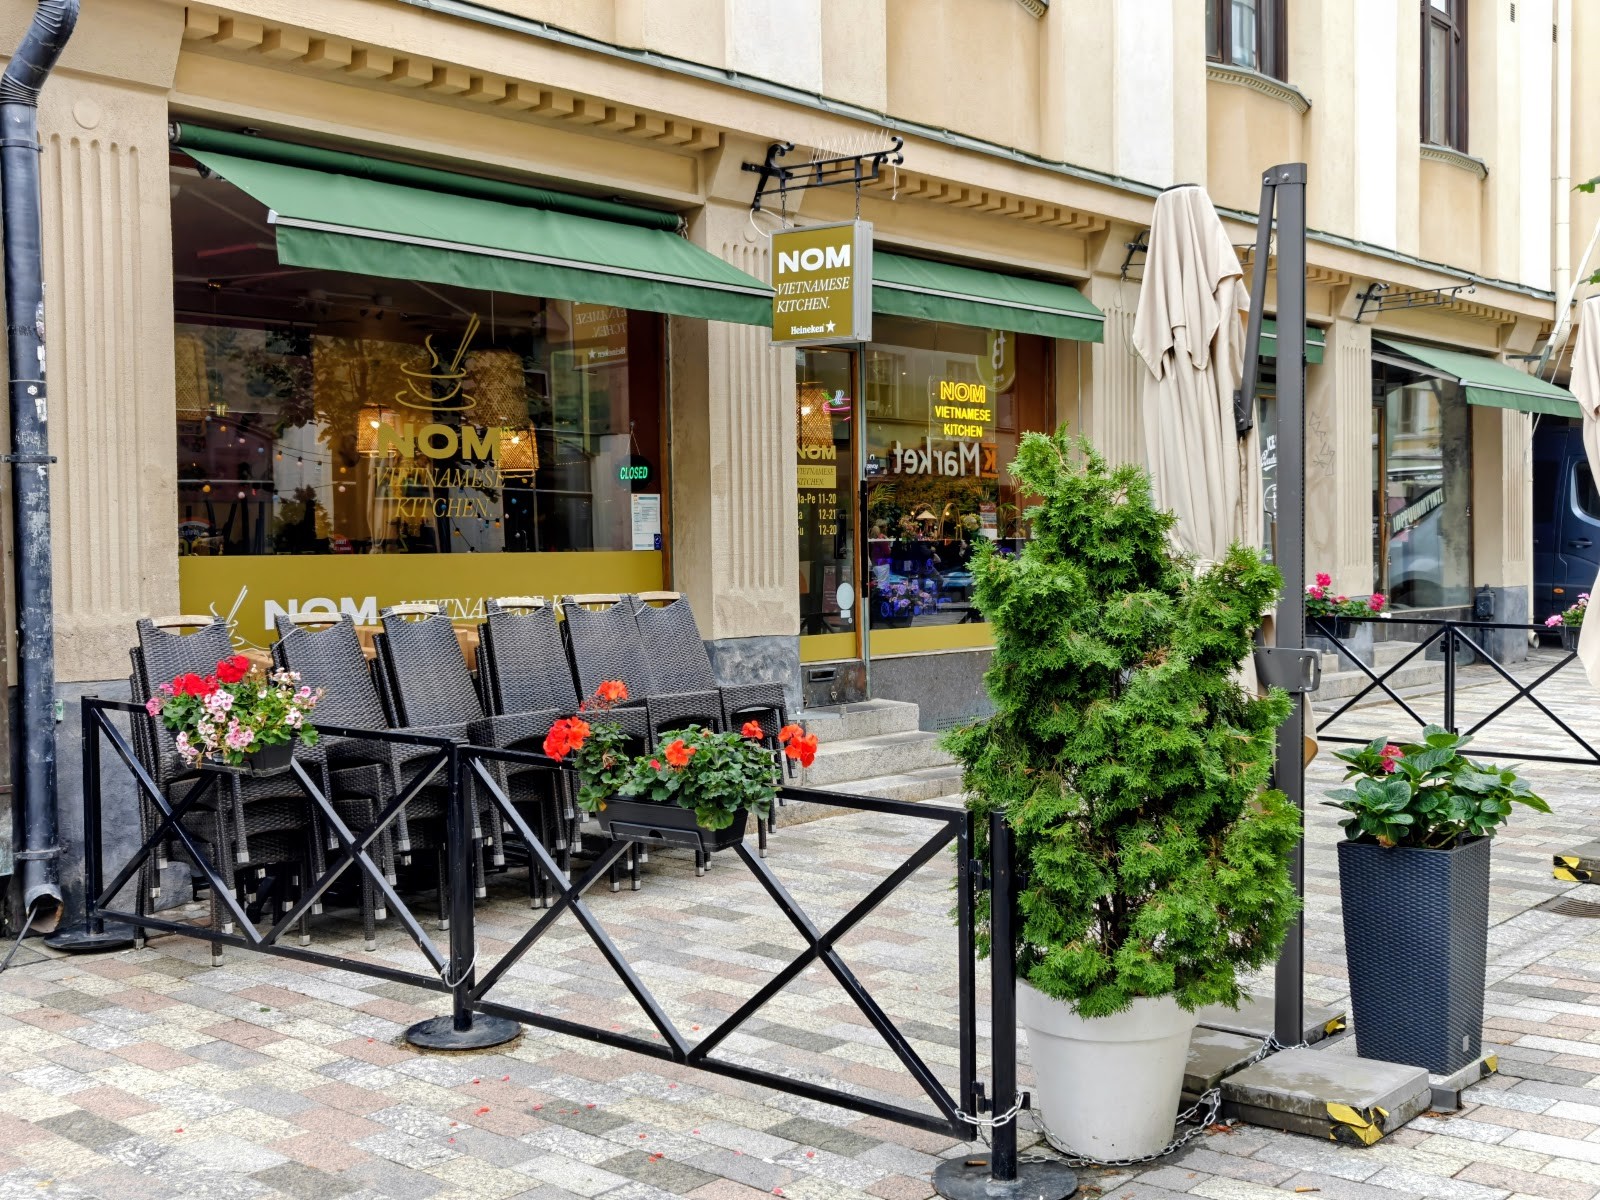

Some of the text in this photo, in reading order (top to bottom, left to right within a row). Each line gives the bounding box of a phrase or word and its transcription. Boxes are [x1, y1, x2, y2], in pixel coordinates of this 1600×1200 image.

[778, 244, 851, 273] NOM
[776, 277, 850, 296] VIETNAMESE
[776, 296, 831, 313] KITCHEN.
[790, 324, 825, 336] Heineken
[940, 380, 986, 404] NOM
[934, 405, 991, 422] VIETNAMESE
[943, 423, 983, 438] KITCHEN
[377, 423, 501, 460] NOM
[797, 444, 837, 460] NOM
[373, 467, 506, 488] VIETNAMESE
[619, 466, 648, 480] CLOSED
[818, 493, 837, 504] 11-20
[394, 497, 493, 518] KITCHEN.
[818, 508, 836, 520] 12-21
[818, 524, 837, 536] 12-20
